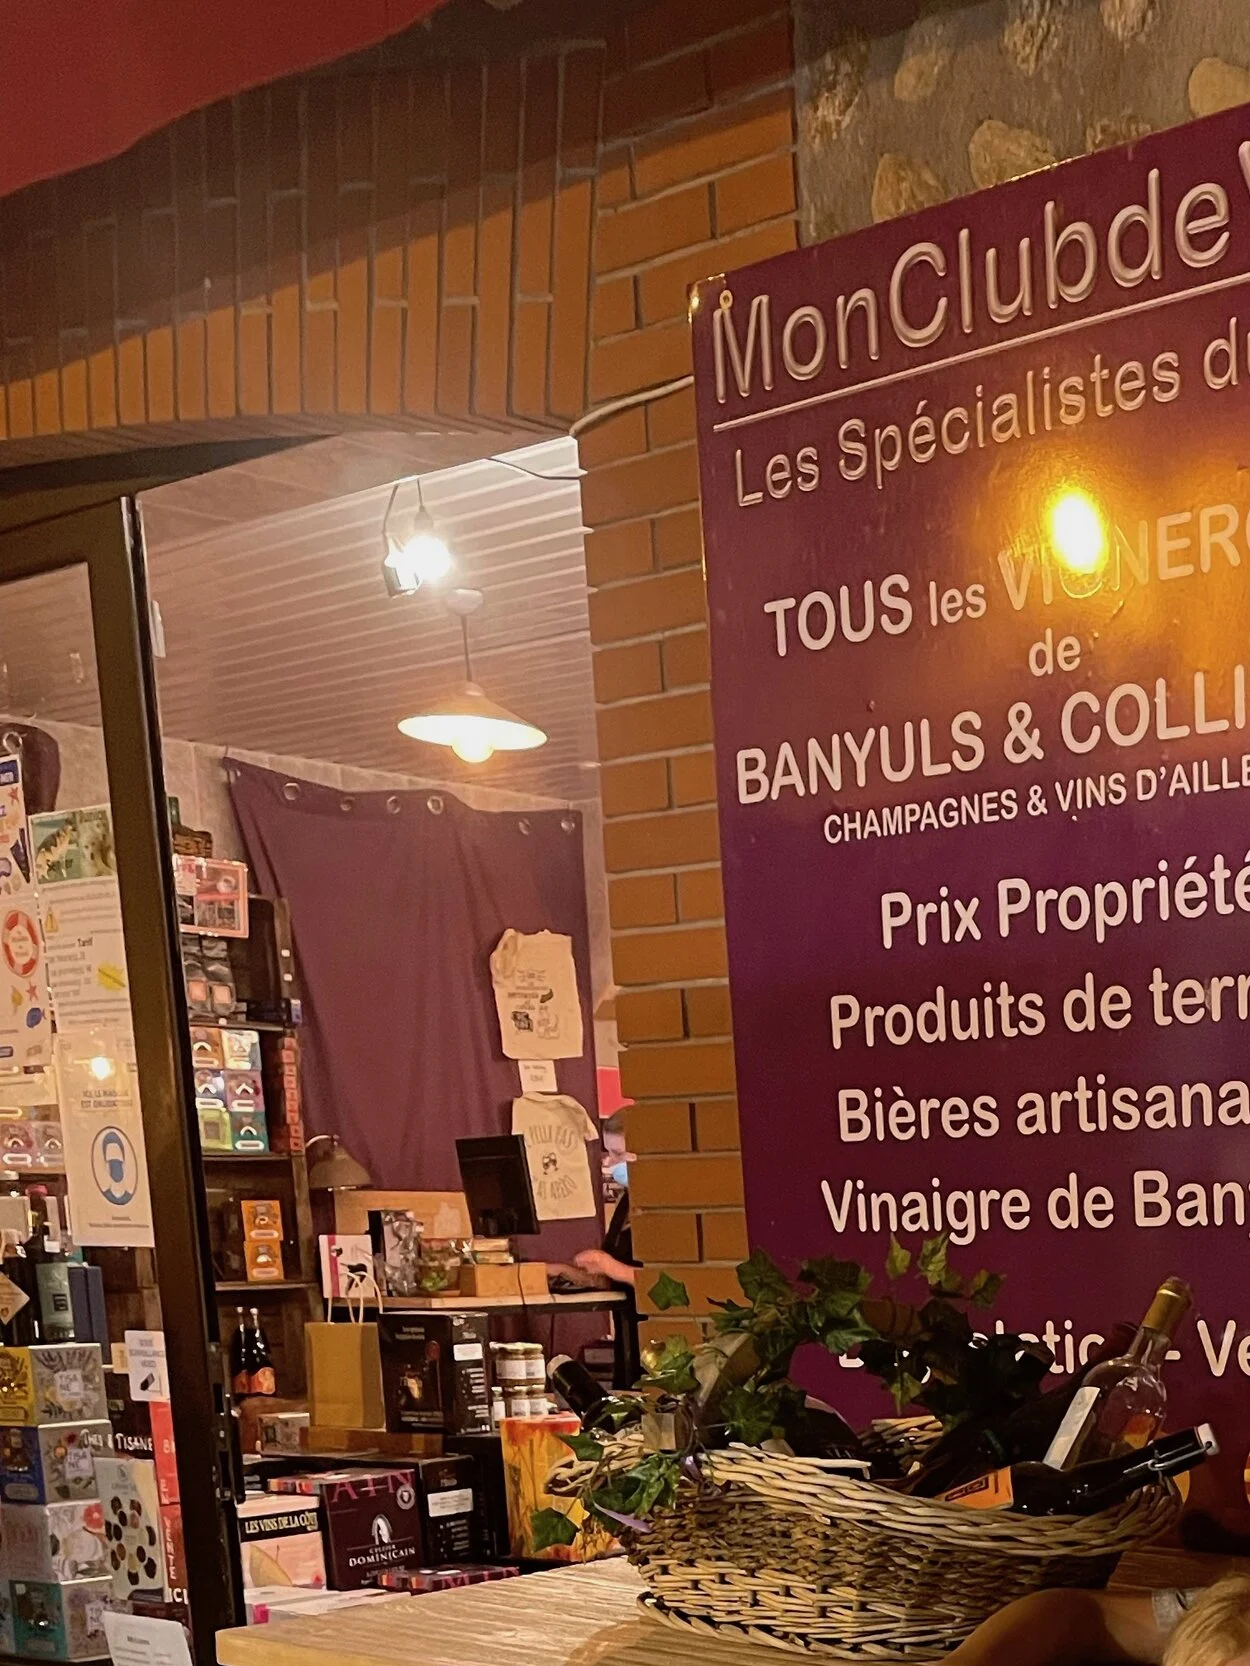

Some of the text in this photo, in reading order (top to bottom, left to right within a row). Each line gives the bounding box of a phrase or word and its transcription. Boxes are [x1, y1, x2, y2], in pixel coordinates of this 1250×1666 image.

[736, 440, 820, 507] Les
[838, 349, 1181, 489] Spécialistes
[764, 574, 913, 657] TOUS
[929, 580, 986, 625] les
[1029, 628, 1082, 677] de
[736, 711, 984, 804] BANYULS
[1003, 702, 1044, 765] &
[823, 788, 1018, 844] CHAMPAGNES
[1026, 786, 1048, 816] &
[1054, 775, 1127, 812] VINS
[880, 887, 982, 949] Prix
[830, 981, 1046, 1050] Produits
[1063, 972, 1133, 1032] de
[838, 1085, 1000, 1142] Bières
[821, 1178, 1031, 1245] Vinaigre
[1047, 1172, 1114, 1229] de
[245, 1520, 259, 1534] LES
[348, 1546, 416, 1567] DOMINICAIN
